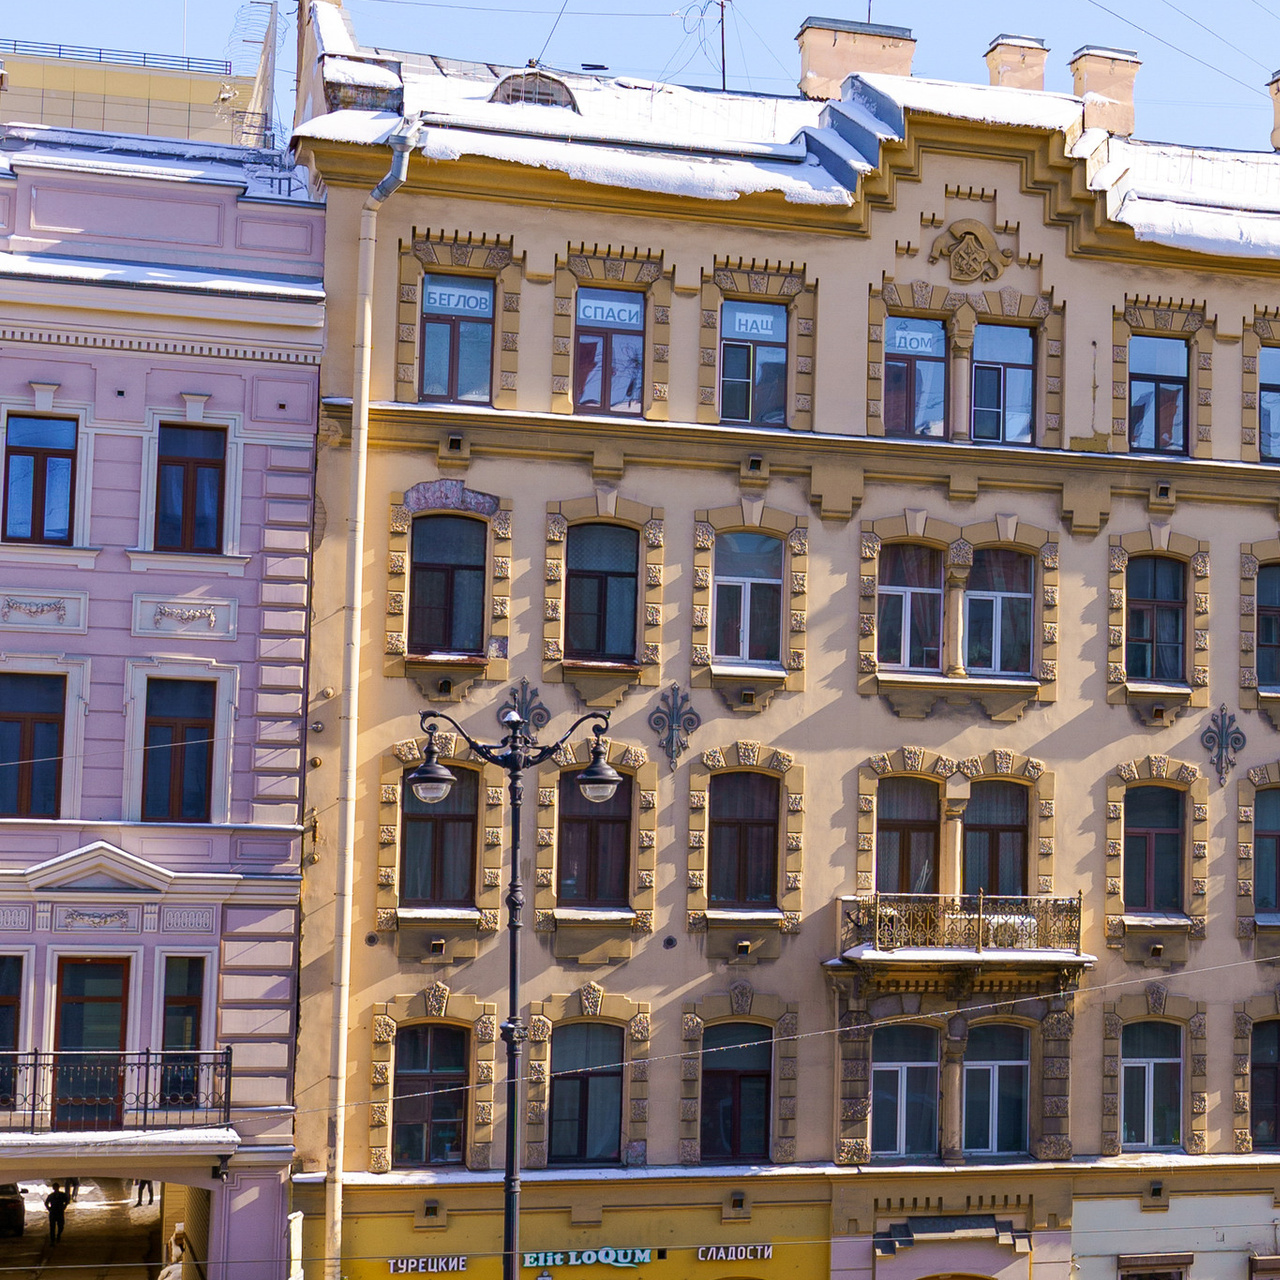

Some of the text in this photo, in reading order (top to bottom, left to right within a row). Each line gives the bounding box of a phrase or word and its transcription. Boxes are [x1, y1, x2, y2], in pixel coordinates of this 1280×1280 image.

[427, 291, 489, 310] БЕГЛОВ
[582, 305, 639, 323] СПАСИ
[738, 318, 772, 333] НАШ
[897, 336, 932, 350] ДОМ
[523, 1247, 651, 1268] Elit LOQUM
[698, 1245, 773, 1260] СЛАДОСТИ
[388, 1256, 467, 1273] ТУРЕЦКИЕ
